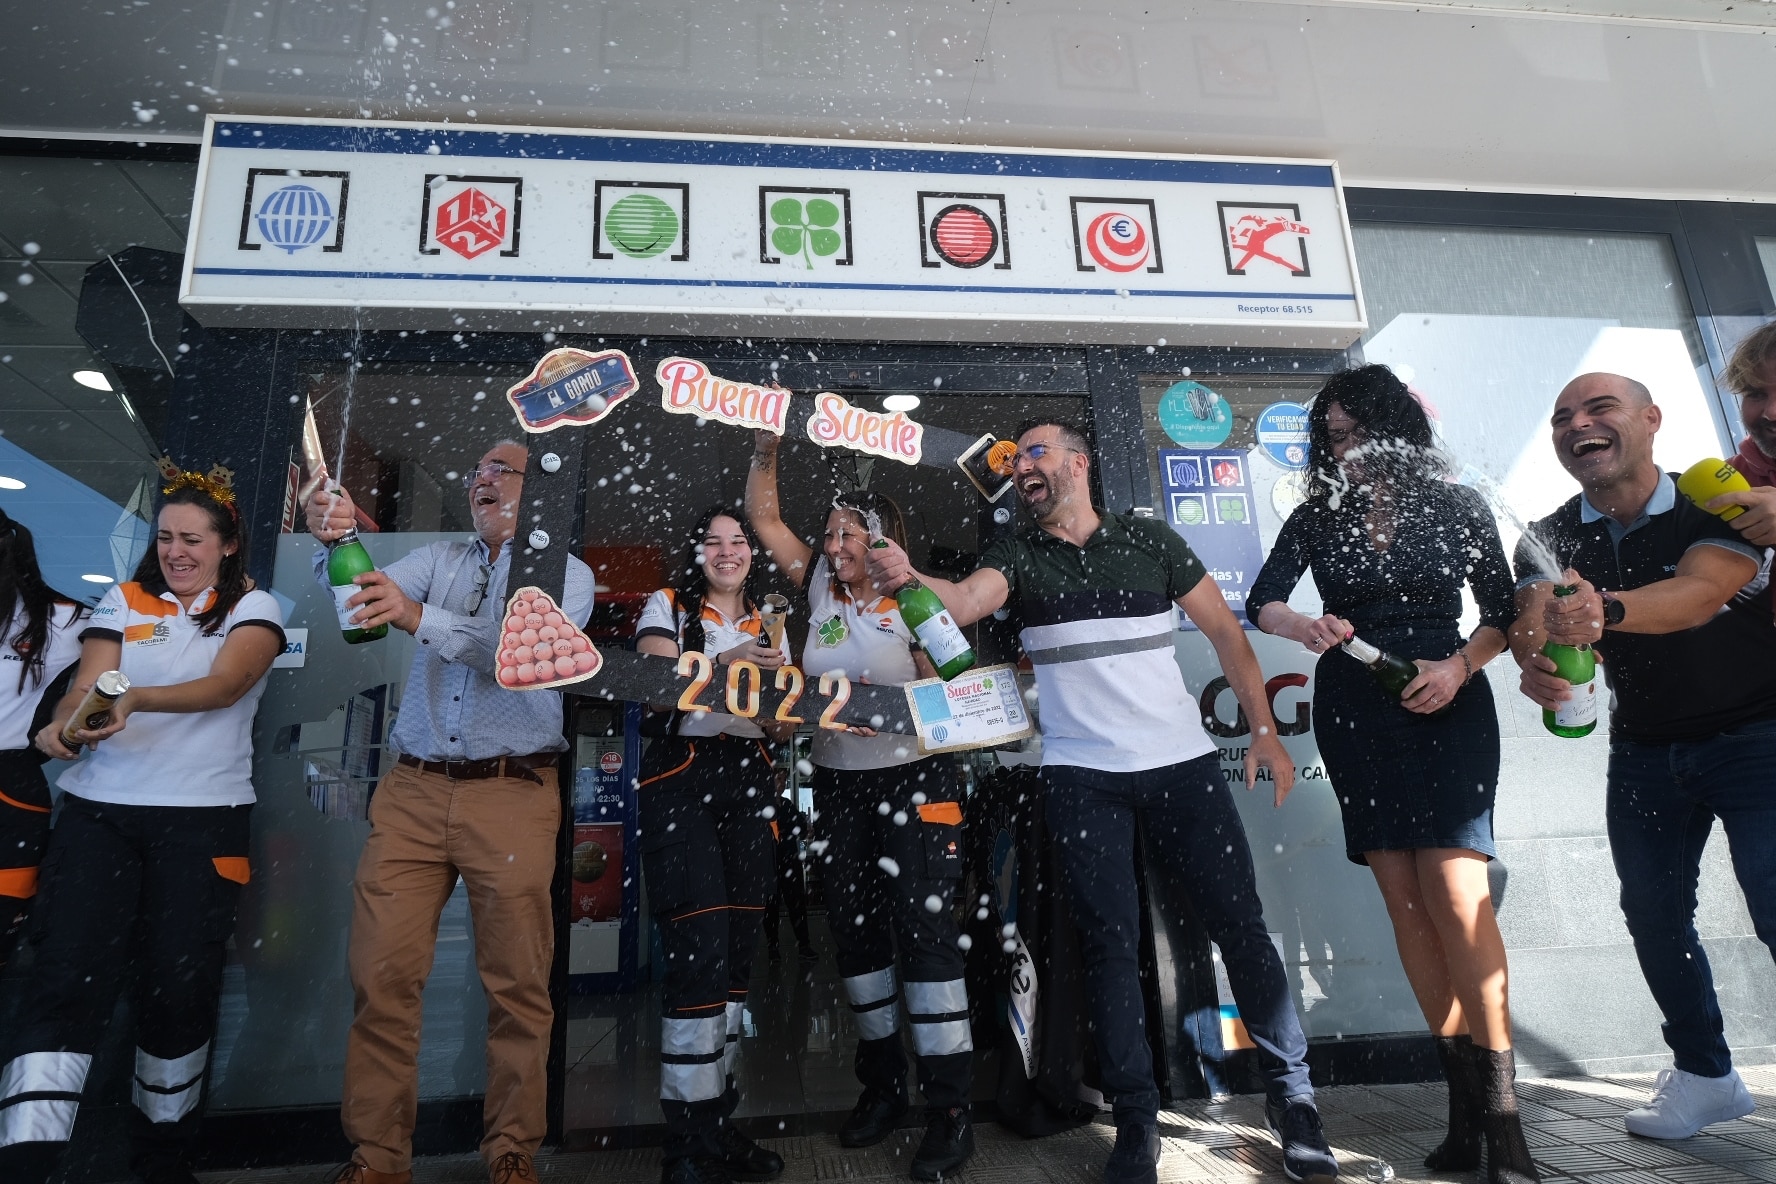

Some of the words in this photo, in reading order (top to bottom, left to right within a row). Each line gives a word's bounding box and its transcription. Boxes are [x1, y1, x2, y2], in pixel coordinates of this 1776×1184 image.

[1237, 304, 1280, 314] Receptor
[1282, 305, 1313, 314] 68.515
[547, 389, 565, 409] EL
[564, 368, 602, 400] GORDO
[661, 360, 785, 429] Buena
[812, 395, 917, 457] Suerte
[1286, 423, 1304, 431] EDAD
[1208, 567, 1233, 581] rías
[1235, 570, 1244, 584] y
[1221, 588, 1242, 601] tas
[286, 642, 303, 654] SA
[677, 650, 852, 730] 2022
[947, 682, 983, 699] Suerte
[598, 794, 620, 803] 22:30
